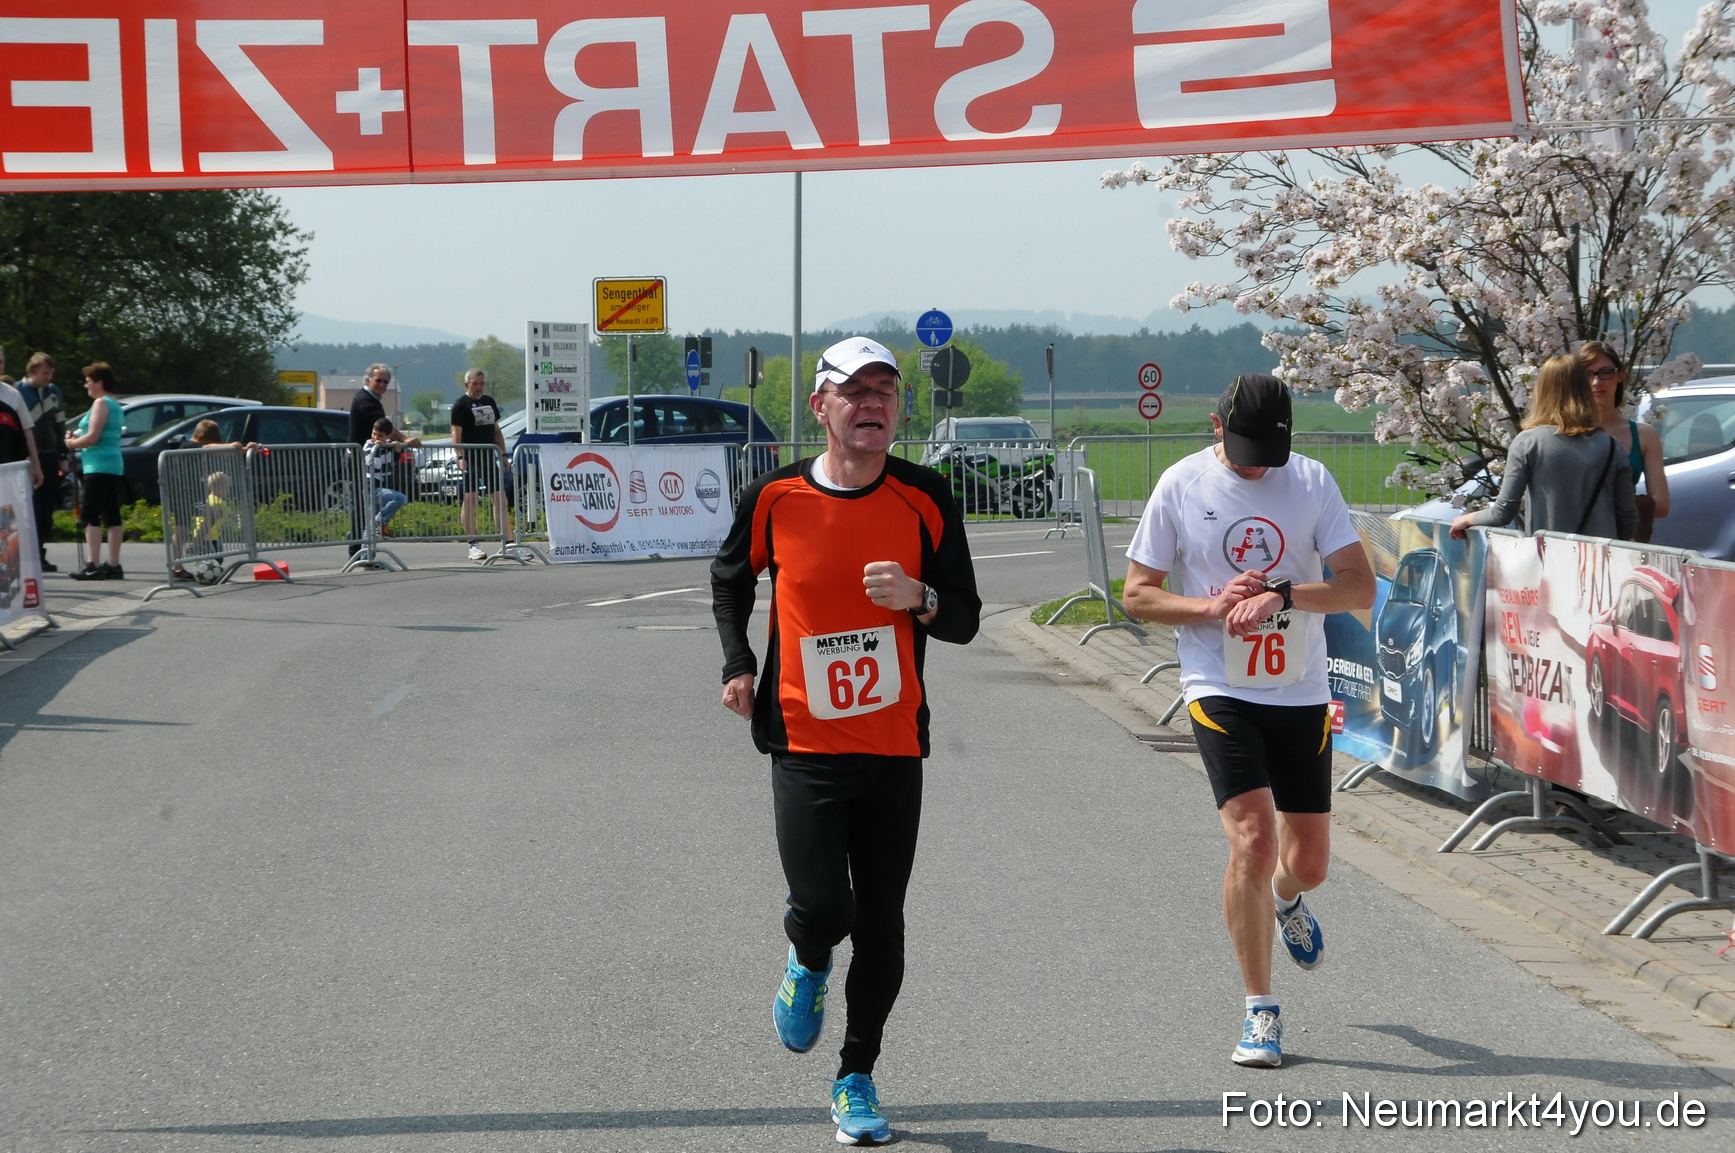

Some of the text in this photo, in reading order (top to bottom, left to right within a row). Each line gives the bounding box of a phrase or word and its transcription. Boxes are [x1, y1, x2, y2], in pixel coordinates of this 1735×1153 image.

[602, 286, 658, 302] Sengenthal
[609, 304, 622, 312] am
[1143, 370, 1157, 383] 60
[541, 399, 561, 412] THULE
[550, 472, 612, 492] GERHART &
[663, 479, 681, 495] KIA
[550, 493, 583, 503] Autohaus
[582, 492, 616, 511] JÄNIG
[626, 508, 654, 517] SEAT
[669, 505, 695, 516] MOTORS
[553, 543, 585, 556] eumarkt
[816, 634, 860, 649] MEYER
[817, 643, 861, 656] WERBUNG
[1242, 632, 1286, 677] 76
[827, 656, 882, 711] 62
[1697, 698, 1728, 714] SEAT
